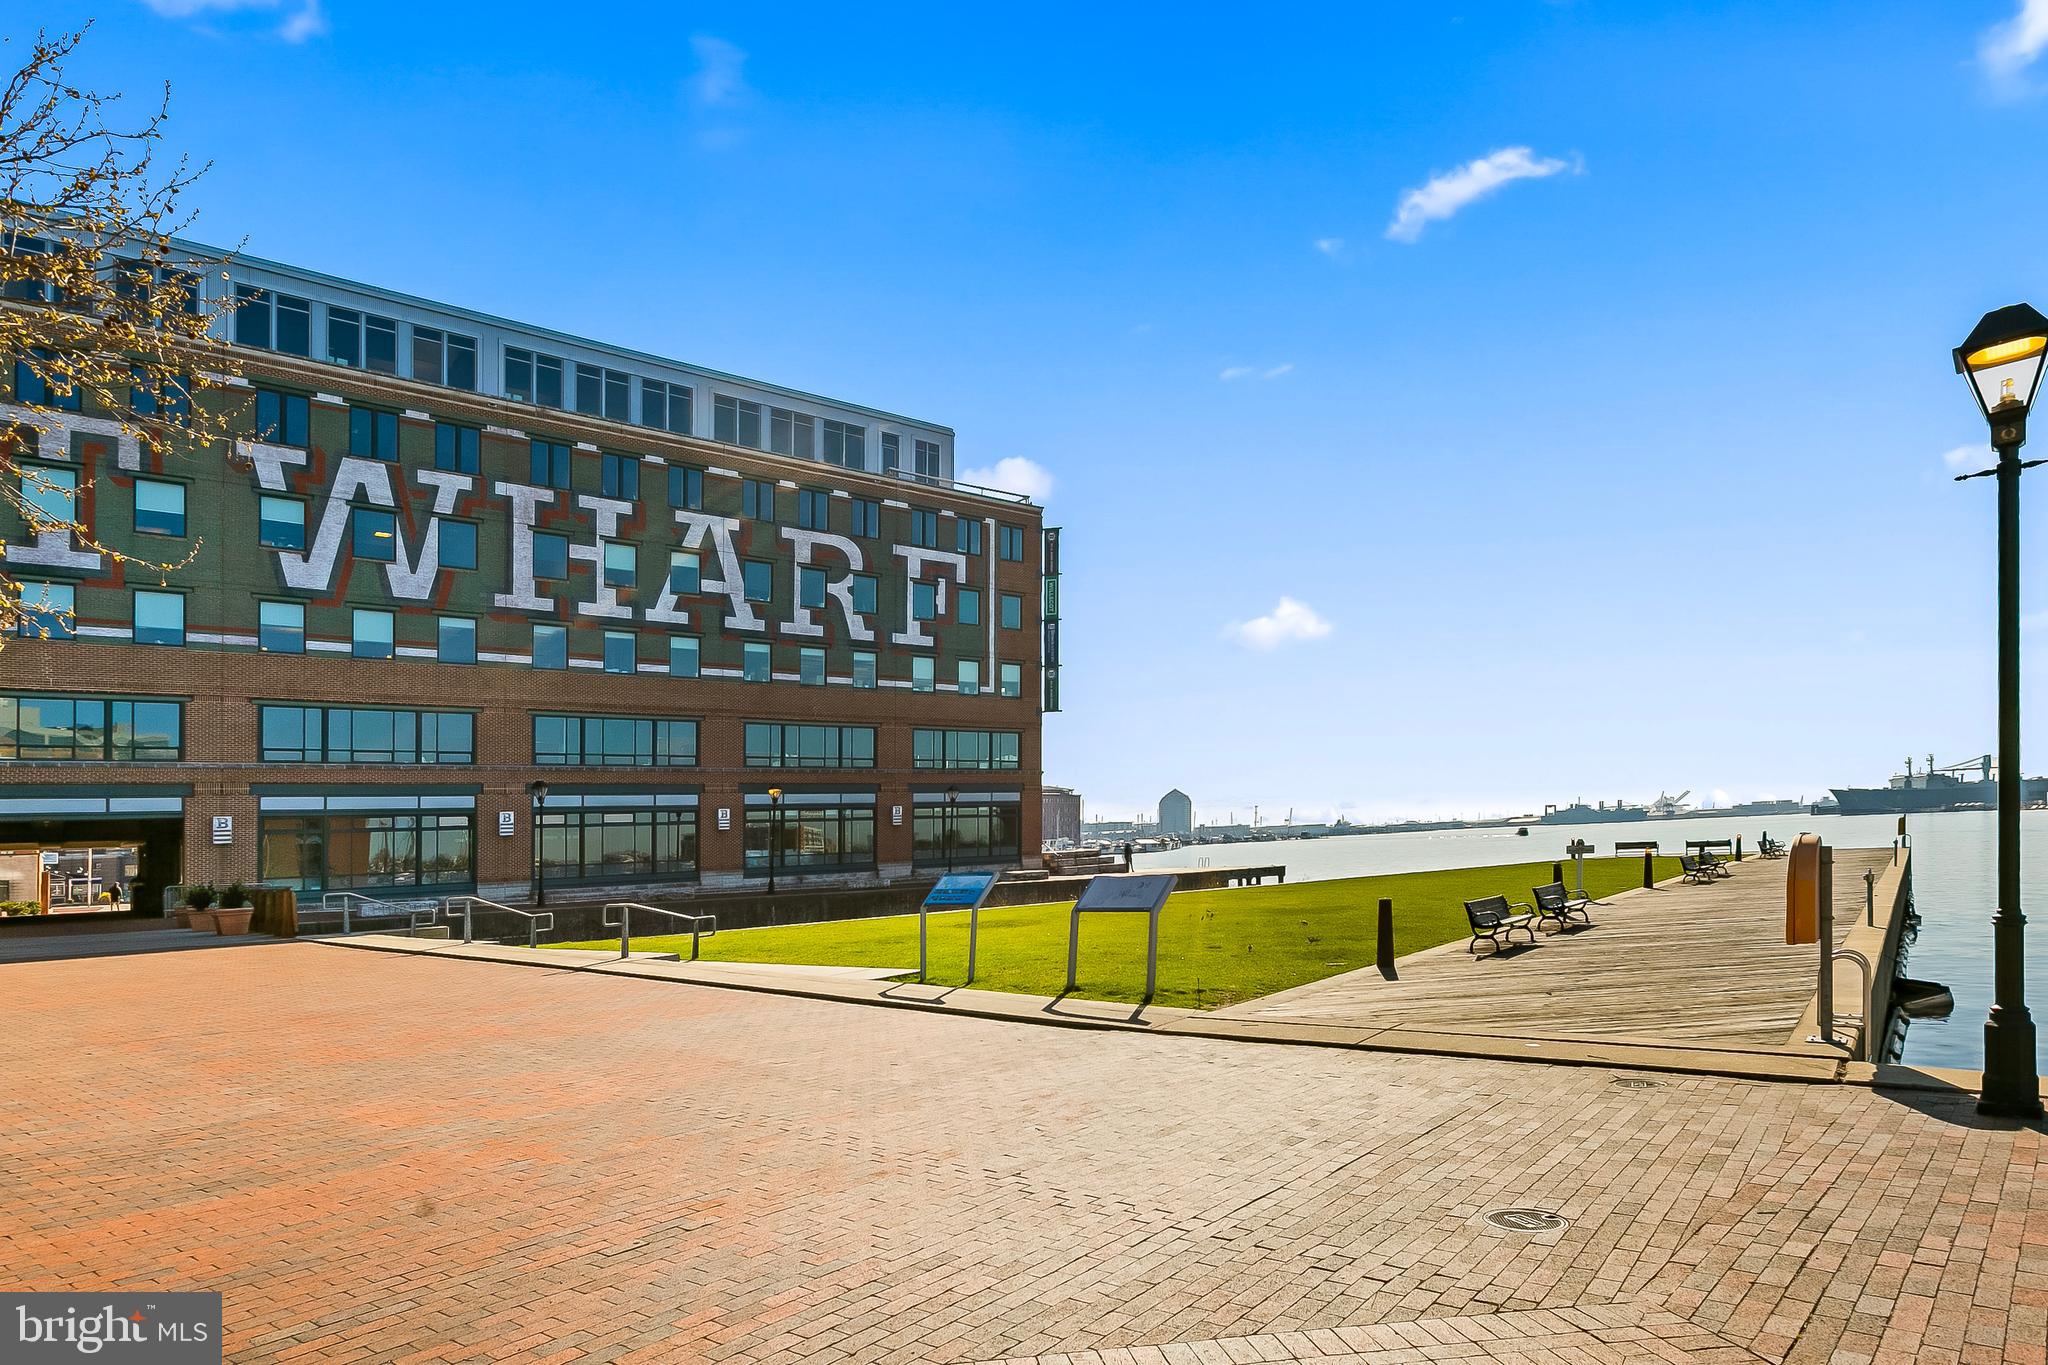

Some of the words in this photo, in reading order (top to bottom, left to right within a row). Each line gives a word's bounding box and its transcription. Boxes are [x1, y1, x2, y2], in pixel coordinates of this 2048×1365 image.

[236, 441, 967, 646] WHARF
[216, 817, 229, 828] B
[502, 812, 512, 822] B
